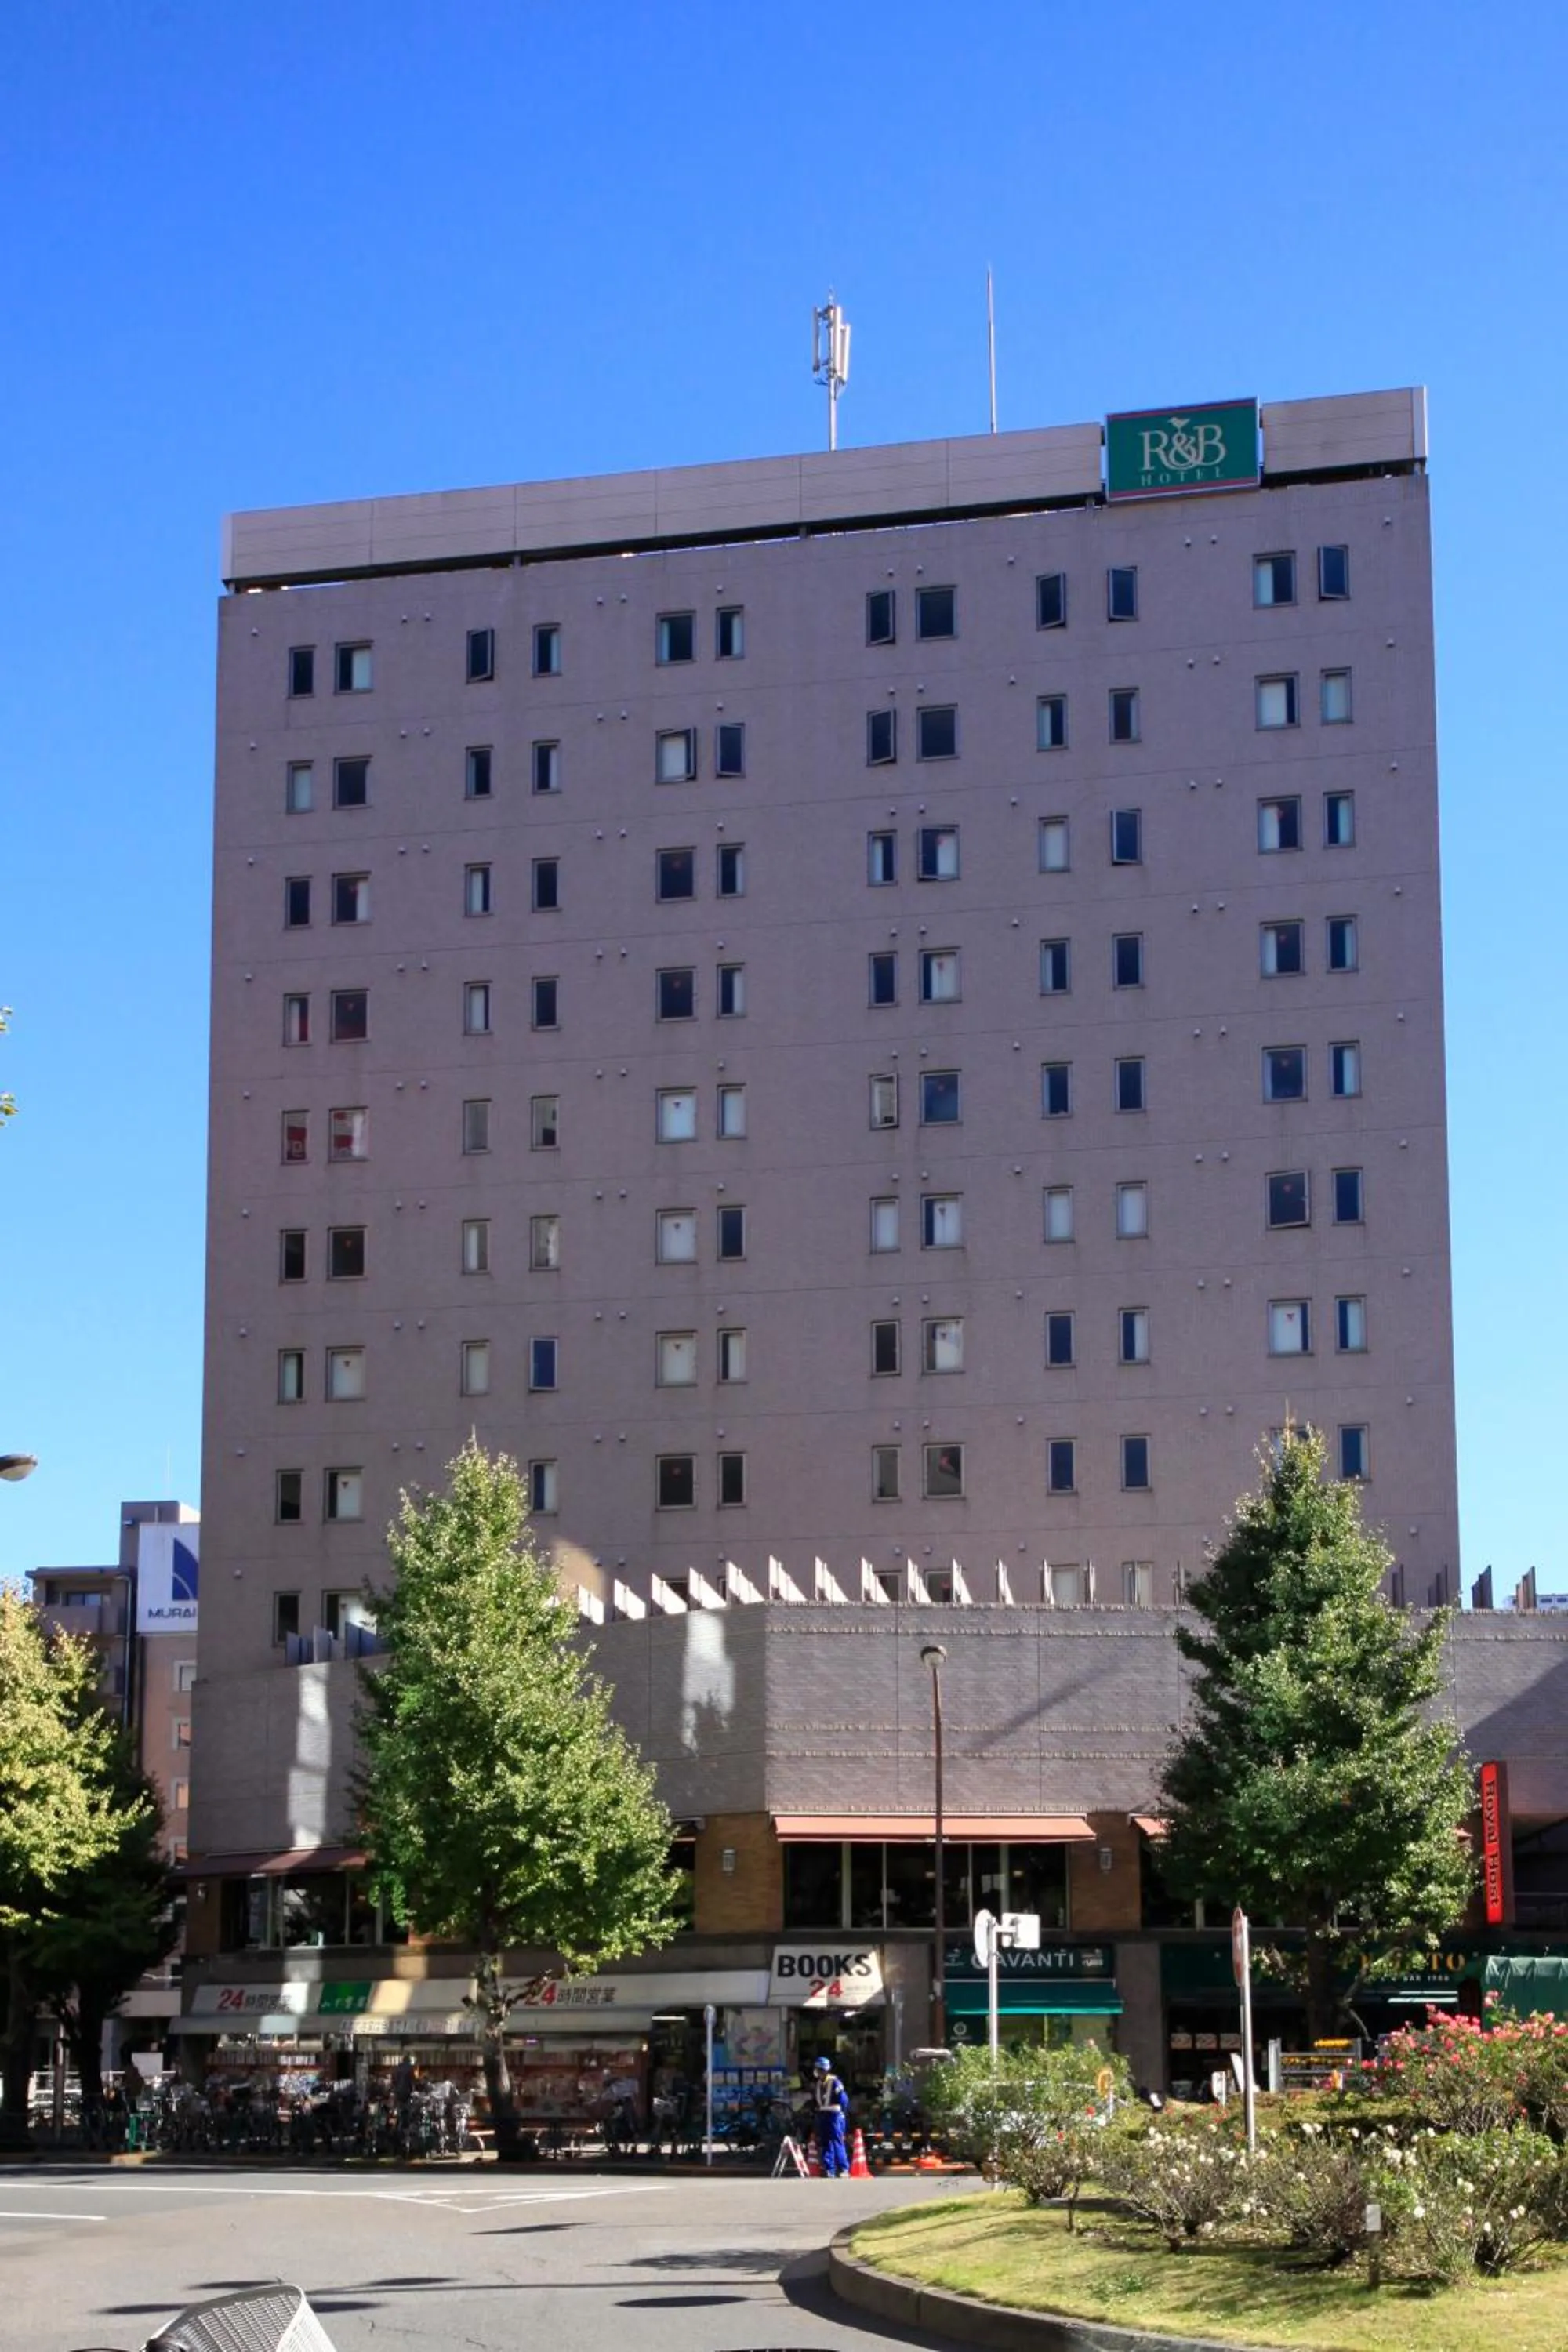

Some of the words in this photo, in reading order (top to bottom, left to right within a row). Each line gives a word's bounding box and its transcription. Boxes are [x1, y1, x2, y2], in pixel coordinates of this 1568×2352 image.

[1138, 423, 1227, 471] R&B
[1141, 467, 1225, 487] HOTEL
[1485, 1780, 1498, 1845] Royal
[1489, 1853, 1501, 1907] Host
[777, 1954, 873, 1978] BOOKS
[809, 1980, 843, 1998] 24
